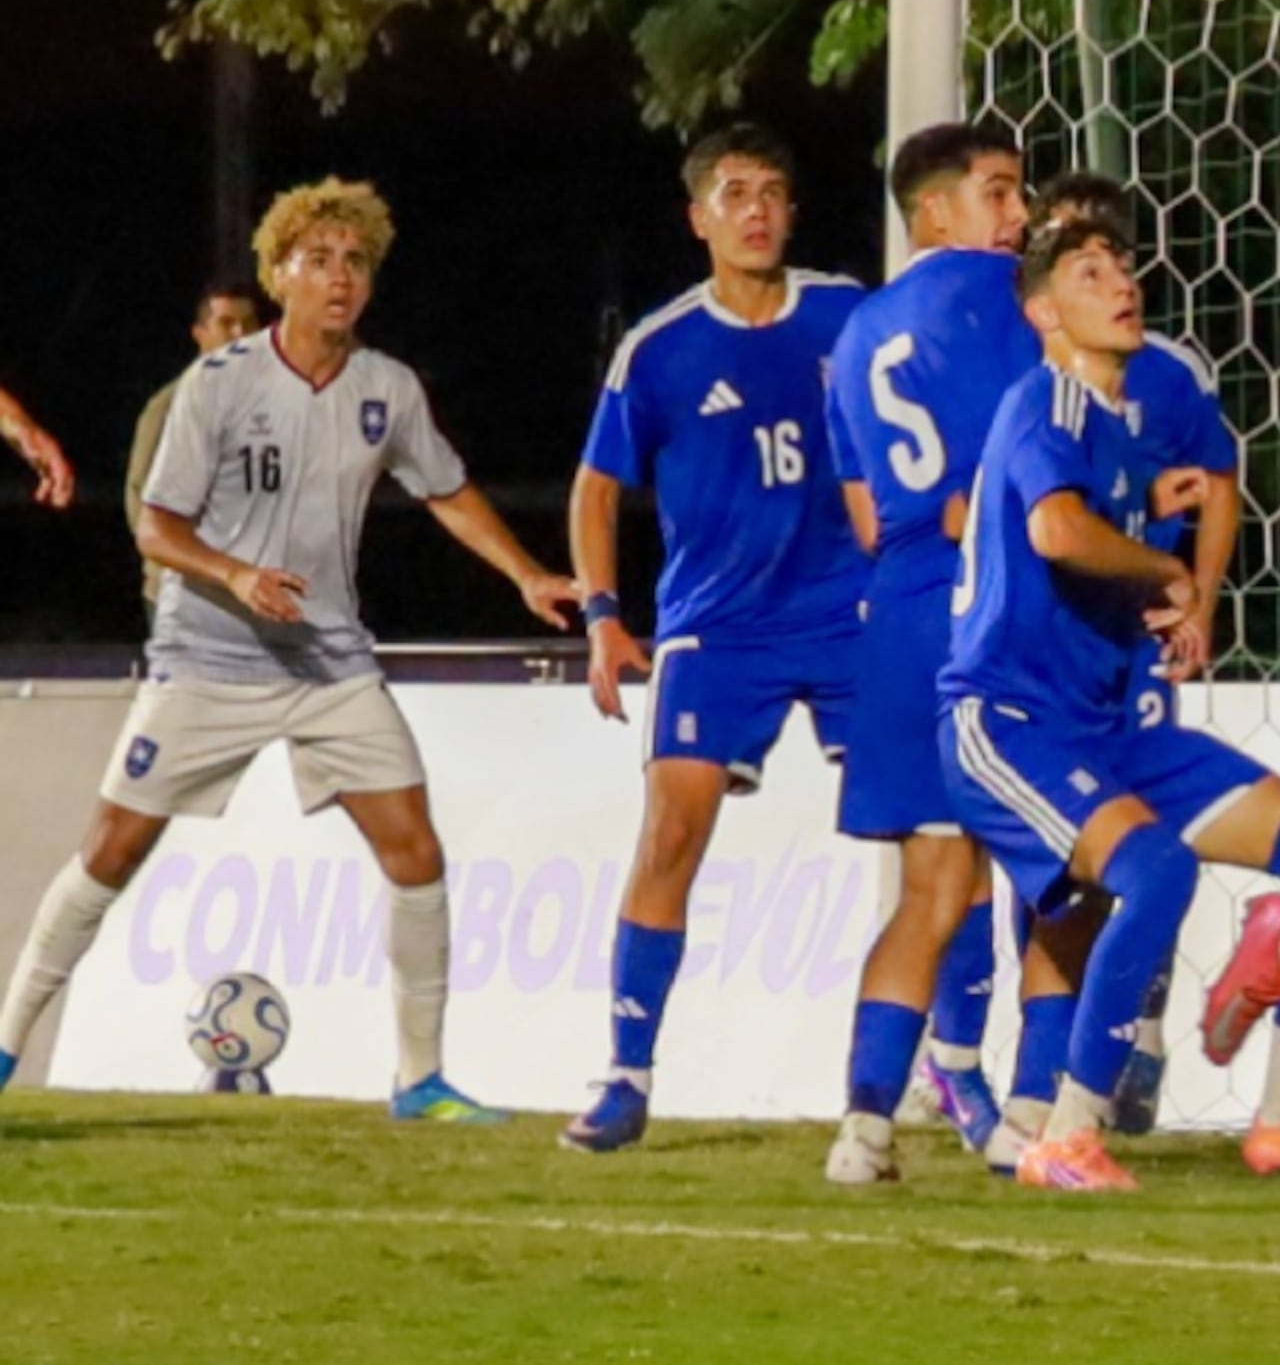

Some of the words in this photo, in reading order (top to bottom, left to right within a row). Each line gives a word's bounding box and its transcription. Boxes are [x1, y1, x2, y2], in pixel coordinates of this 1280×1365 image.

[753, 419, 805, 488] 16
[869, 332, 946, 493] 5
[239, 445, 281, 494] 16
[128, 852, 622, 994] CONMBOL
